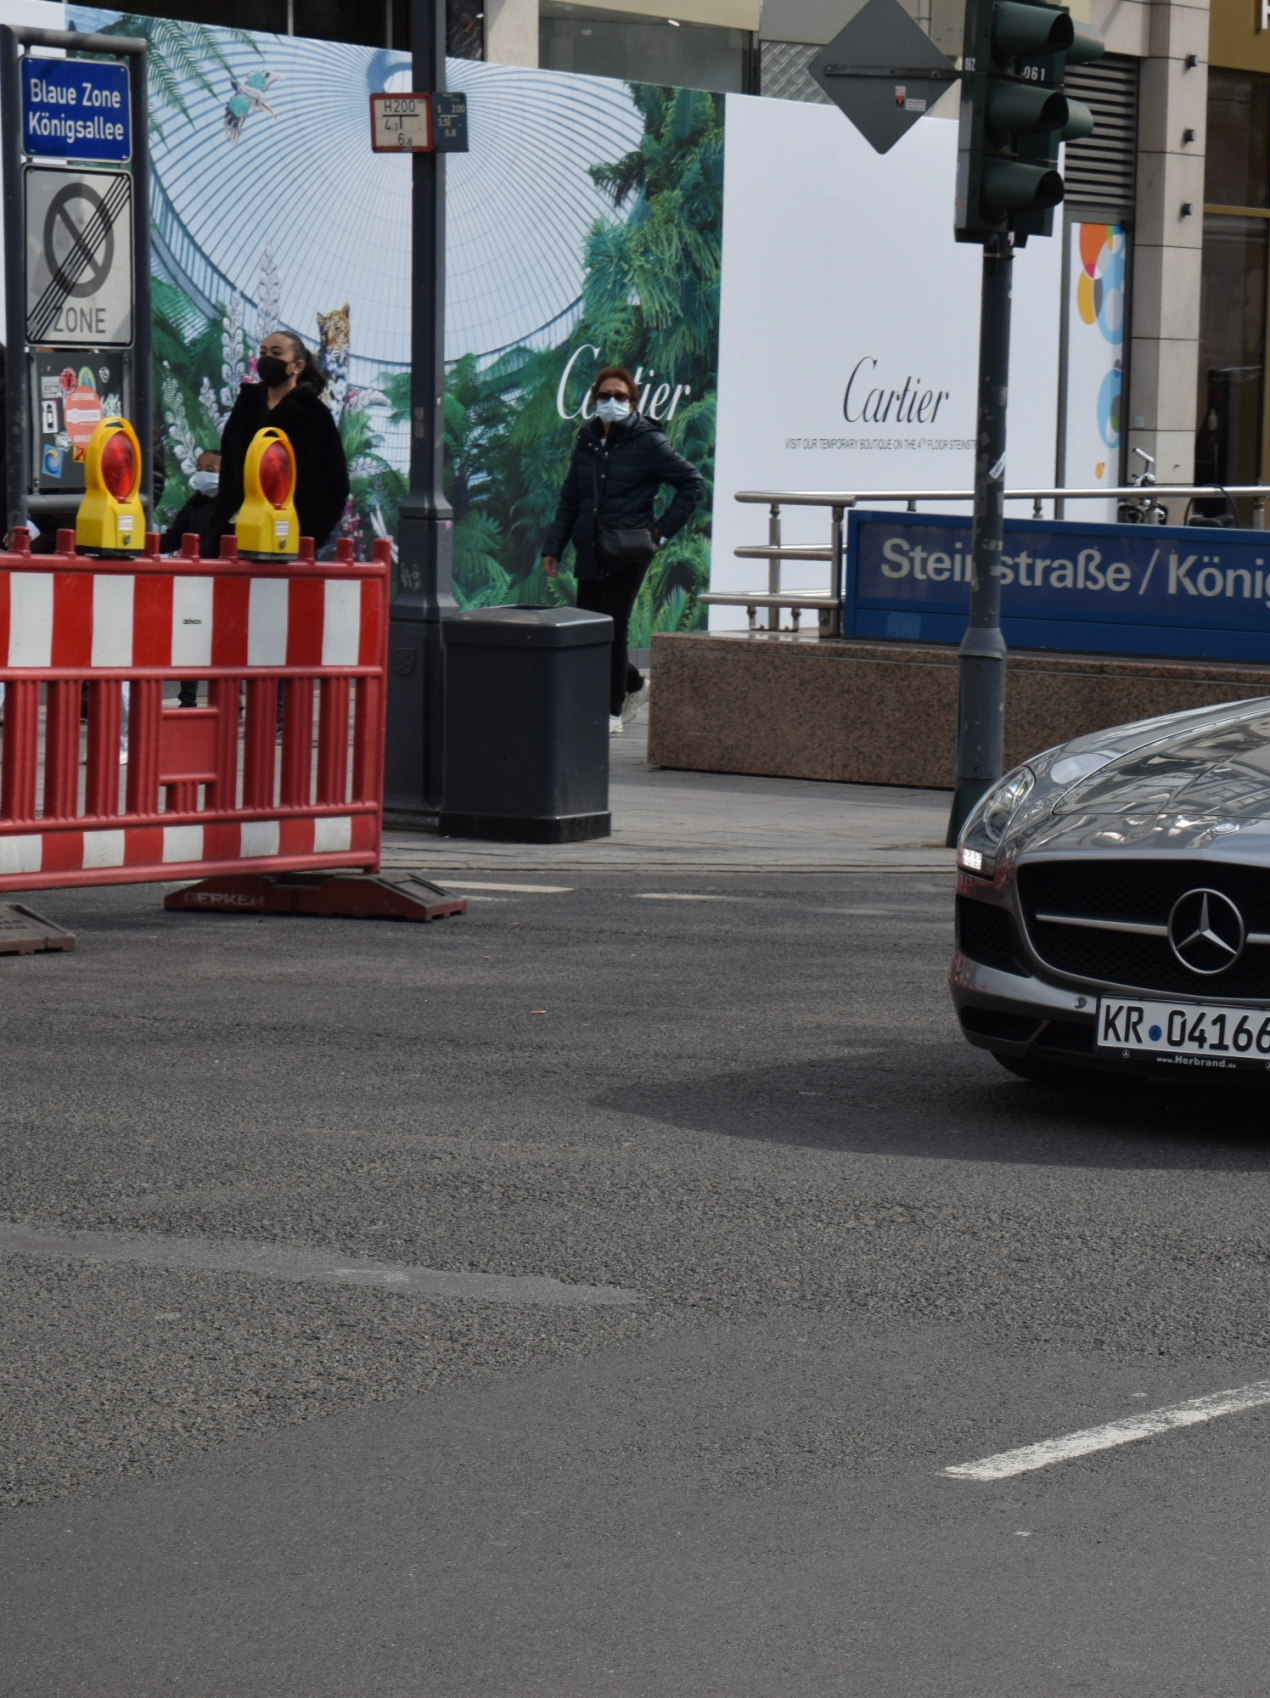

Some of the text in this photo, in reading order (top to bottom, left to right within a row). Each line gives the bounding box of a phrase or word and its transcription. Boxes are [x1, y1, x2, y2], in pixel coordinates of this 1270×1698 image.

[1023, 66, 1046, 81] 061
[30, 78, 121, 108] Blaue Zone
[384, 100, 415, 113] H200
[29, 111, 124, 143] Königsallee
[53, 306, 107, 334] ZONE
[843, 356, 949, 423] Cartier
[784, 438, 801, 450] VISIT
[803, 438, 817, 450] OUR
[819, 438, 858, 450] TEMPORARY
[860, 438, 892, 450] BOUTIQUE
[893, 438, 903, 450] ON
[904, 438, 916, 450] THE
[928, 439, 947, 450] FLOOR
[881, 537, 1132, 592] Steistraße
[184, 892, 264, 907] GERKEN
[1103, 1004, 1144, 1043] KR
[1156, 1055, 1237, 1069] www.Herbrand.de
